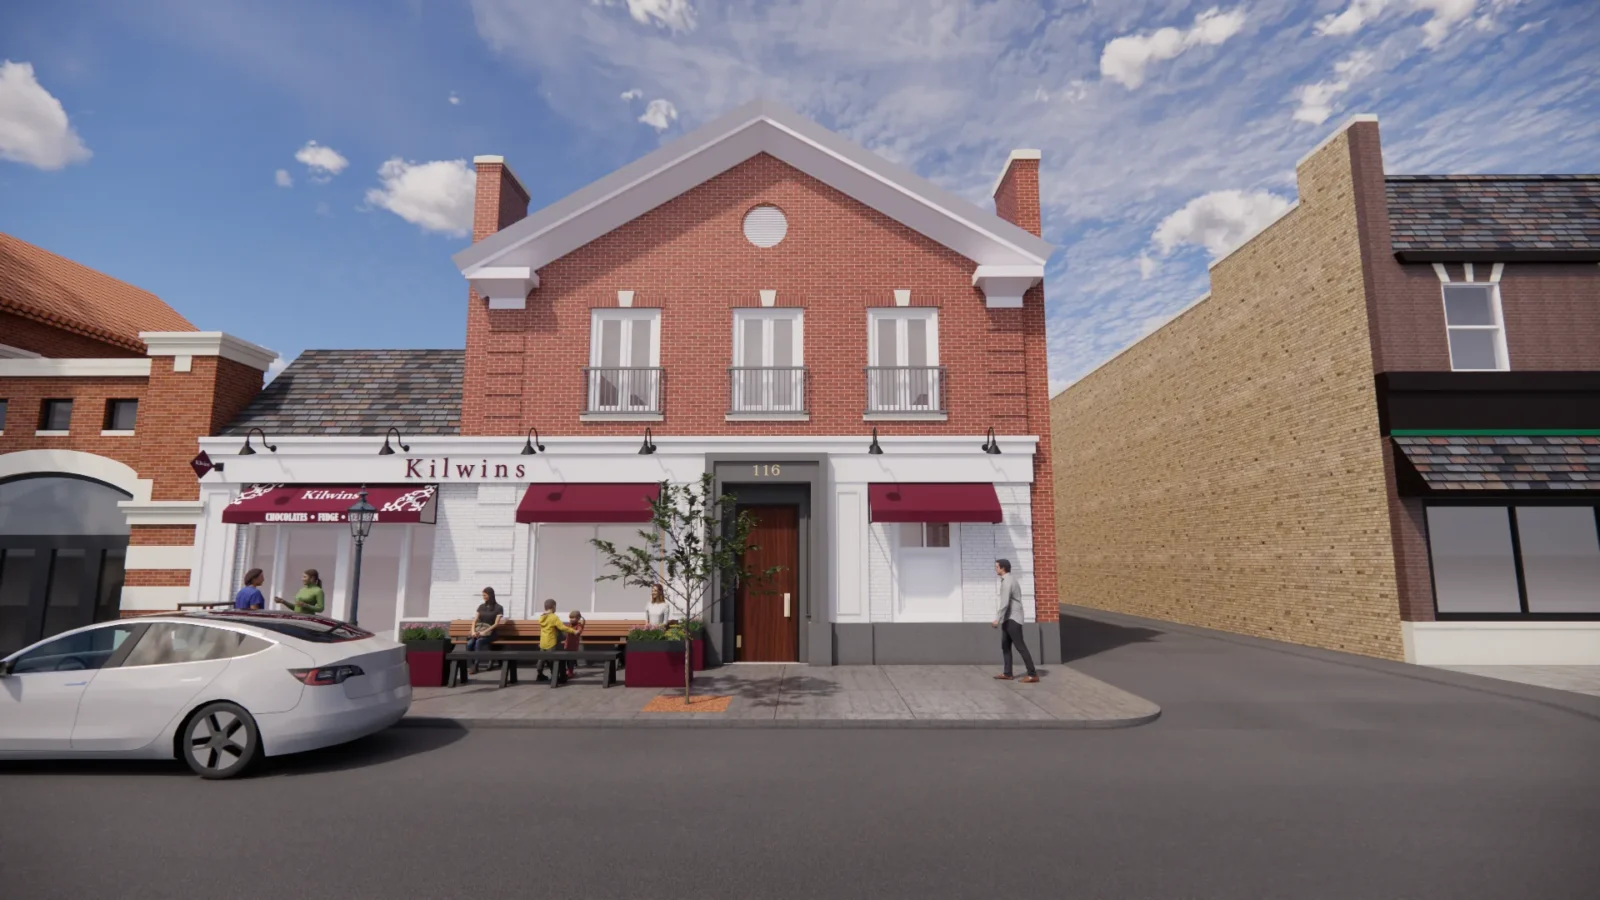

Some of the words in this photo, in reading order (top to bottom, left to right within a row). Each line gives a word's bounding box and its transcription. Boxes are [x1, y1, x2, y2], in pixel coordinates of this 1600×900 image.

[405, 457, 525, 478] Kilwins
[752, 463, 780, 477] 116
[301, 490, 360, 500] Kilwins
[265, 512, 308, 522] CHOCOLATES
[317, 512, 339, 522] FUDGE
